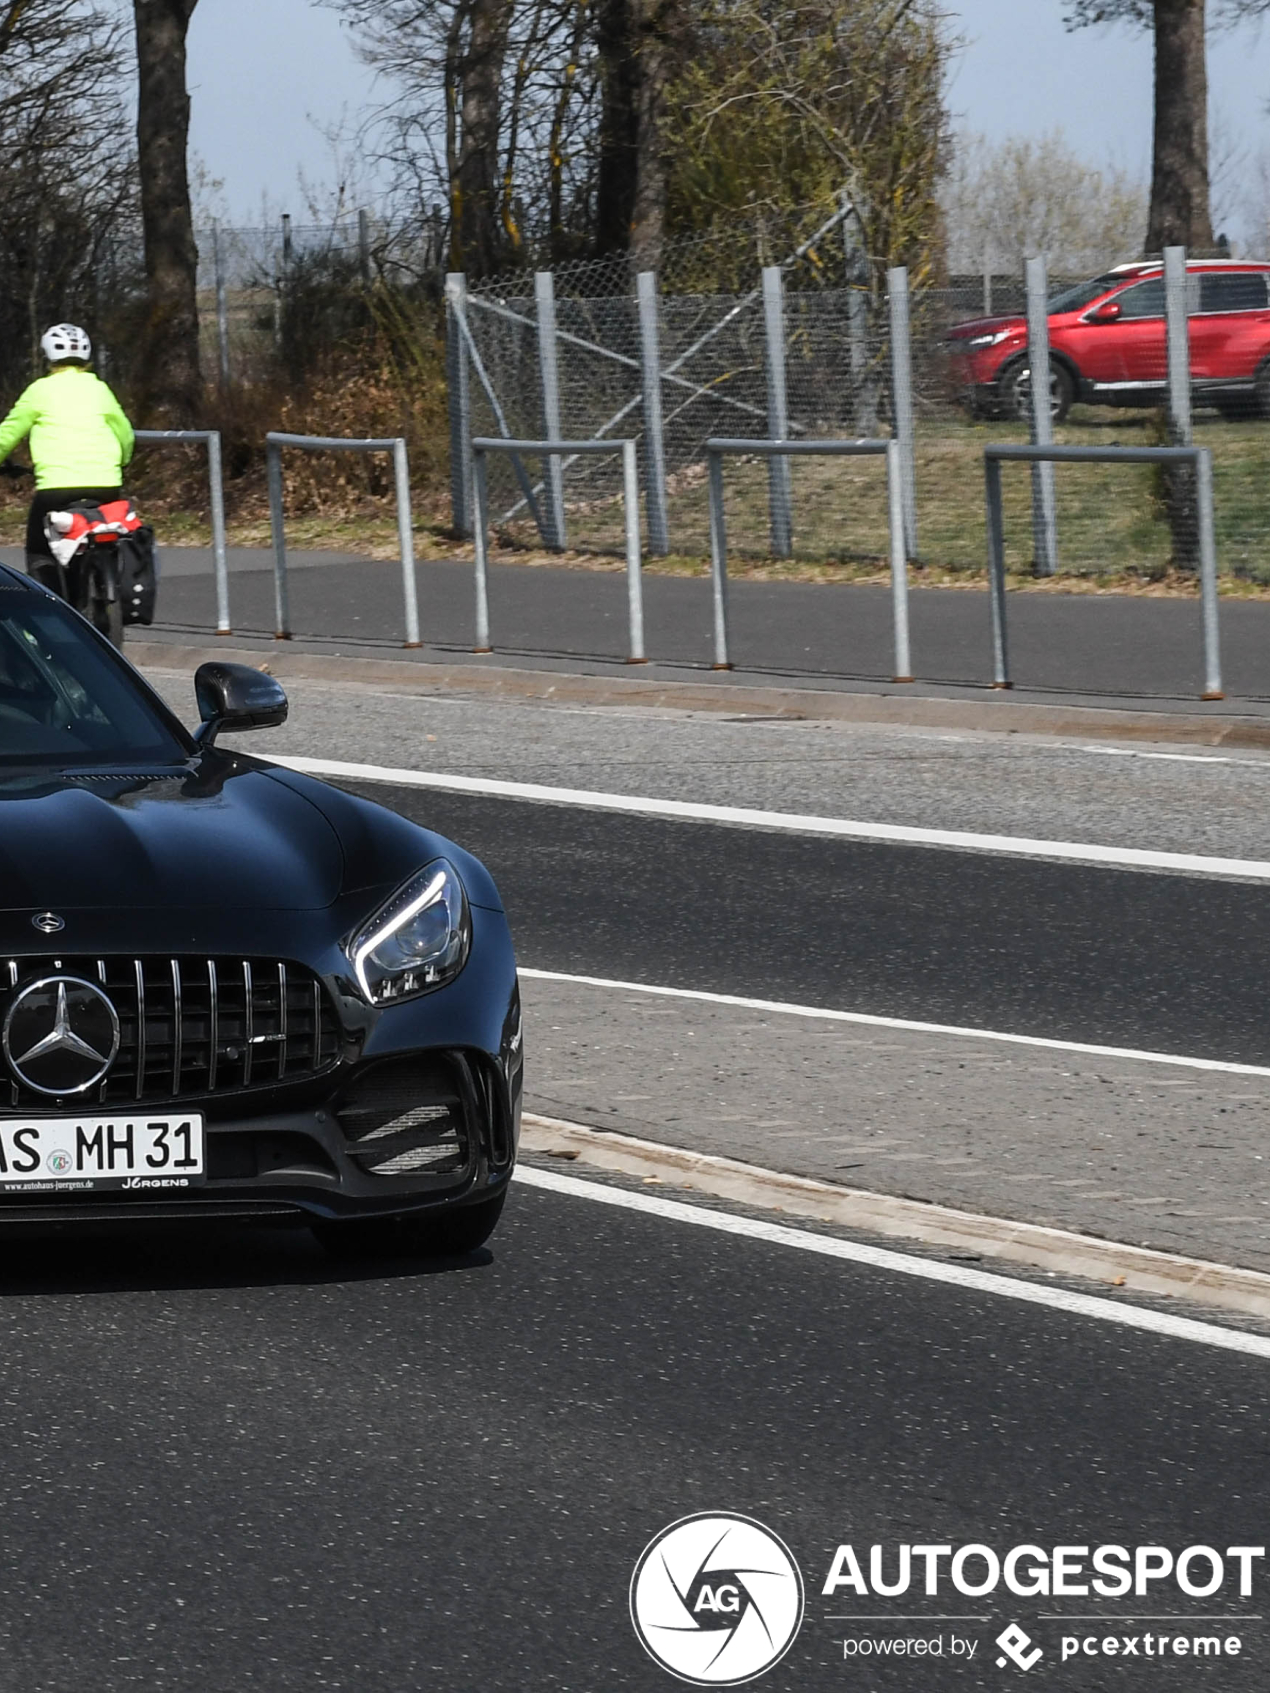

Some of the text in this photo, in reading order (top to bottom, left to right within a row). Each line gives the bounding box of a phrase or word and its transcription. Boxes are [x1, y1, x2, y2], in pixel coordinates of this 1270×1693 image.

[76, 1124, 134, 1170] MH
[145, 1122, 198, 1168] 31
[4, 1180, 94, 1191] www.autohaus-juergens.de
